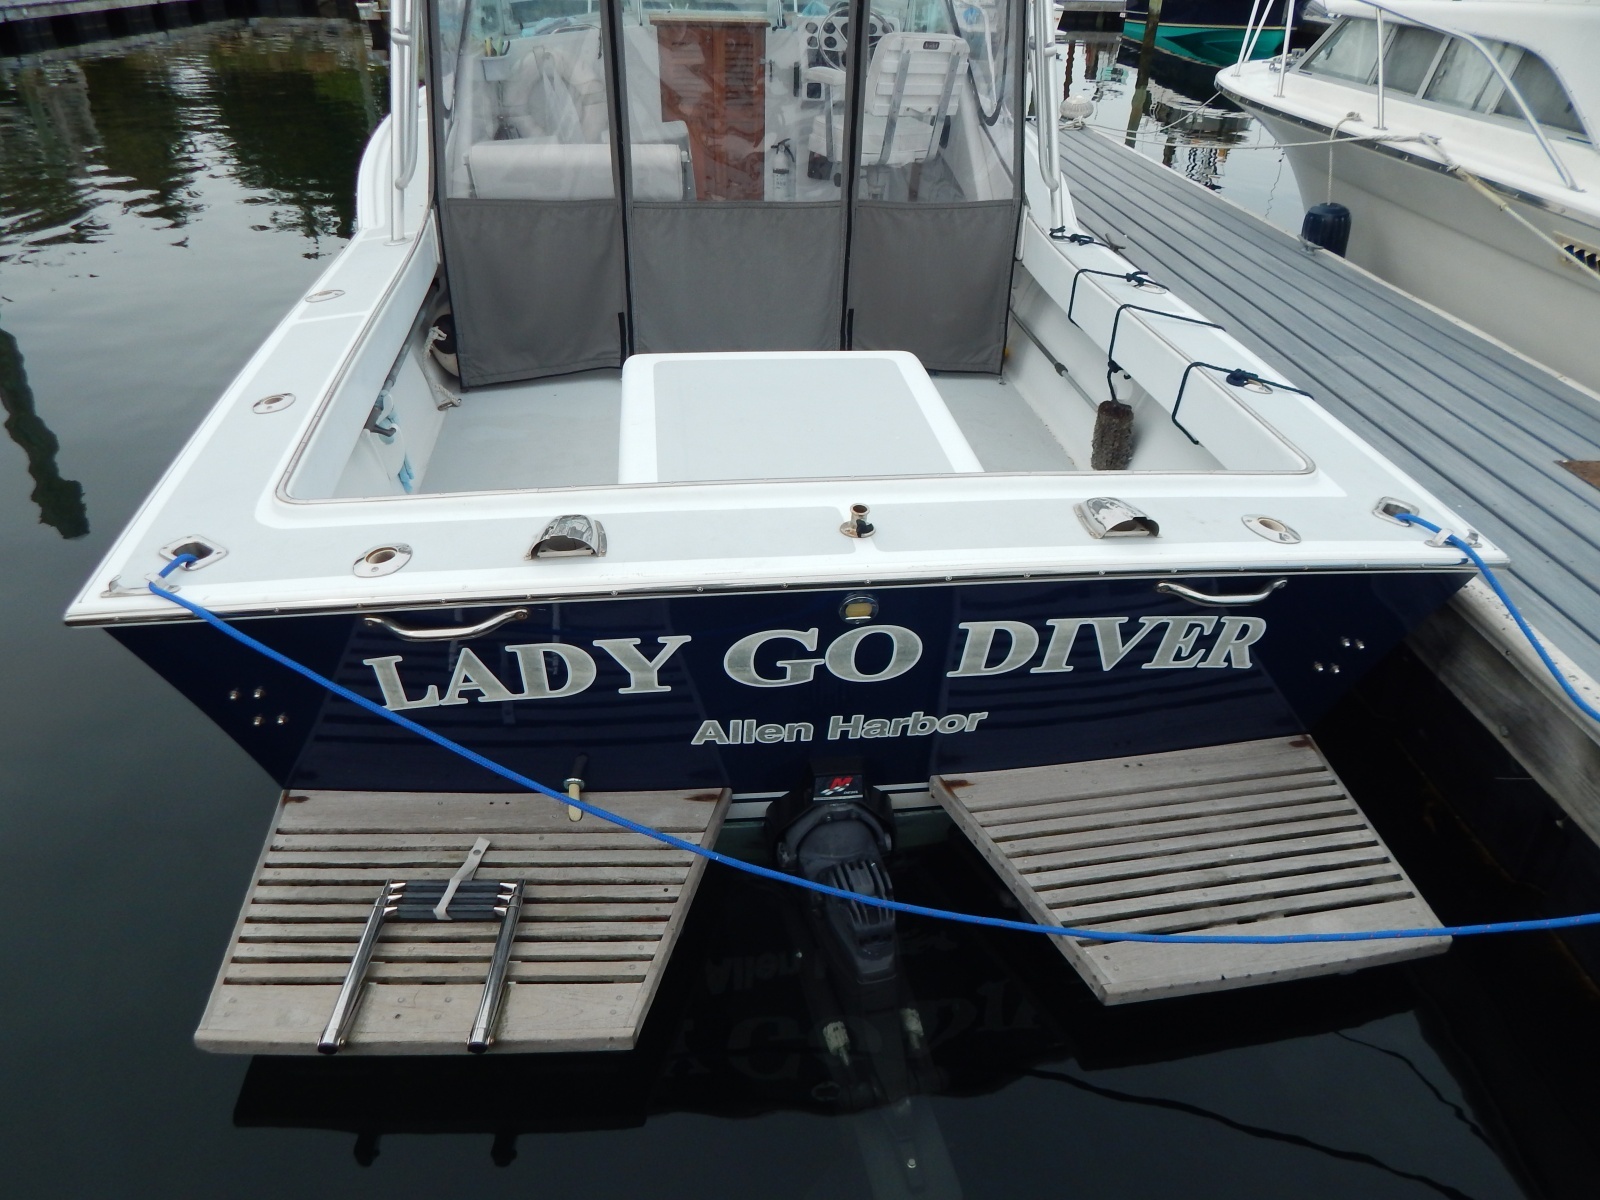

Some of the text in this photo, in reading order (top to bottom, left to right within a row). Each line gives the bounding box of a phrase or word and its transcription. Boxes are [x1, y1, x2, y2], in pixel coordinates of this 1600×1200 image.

[362, 615, 1267, 711] LADY GO DIVER
[691, 711, 988, 745] Allen Harbor
